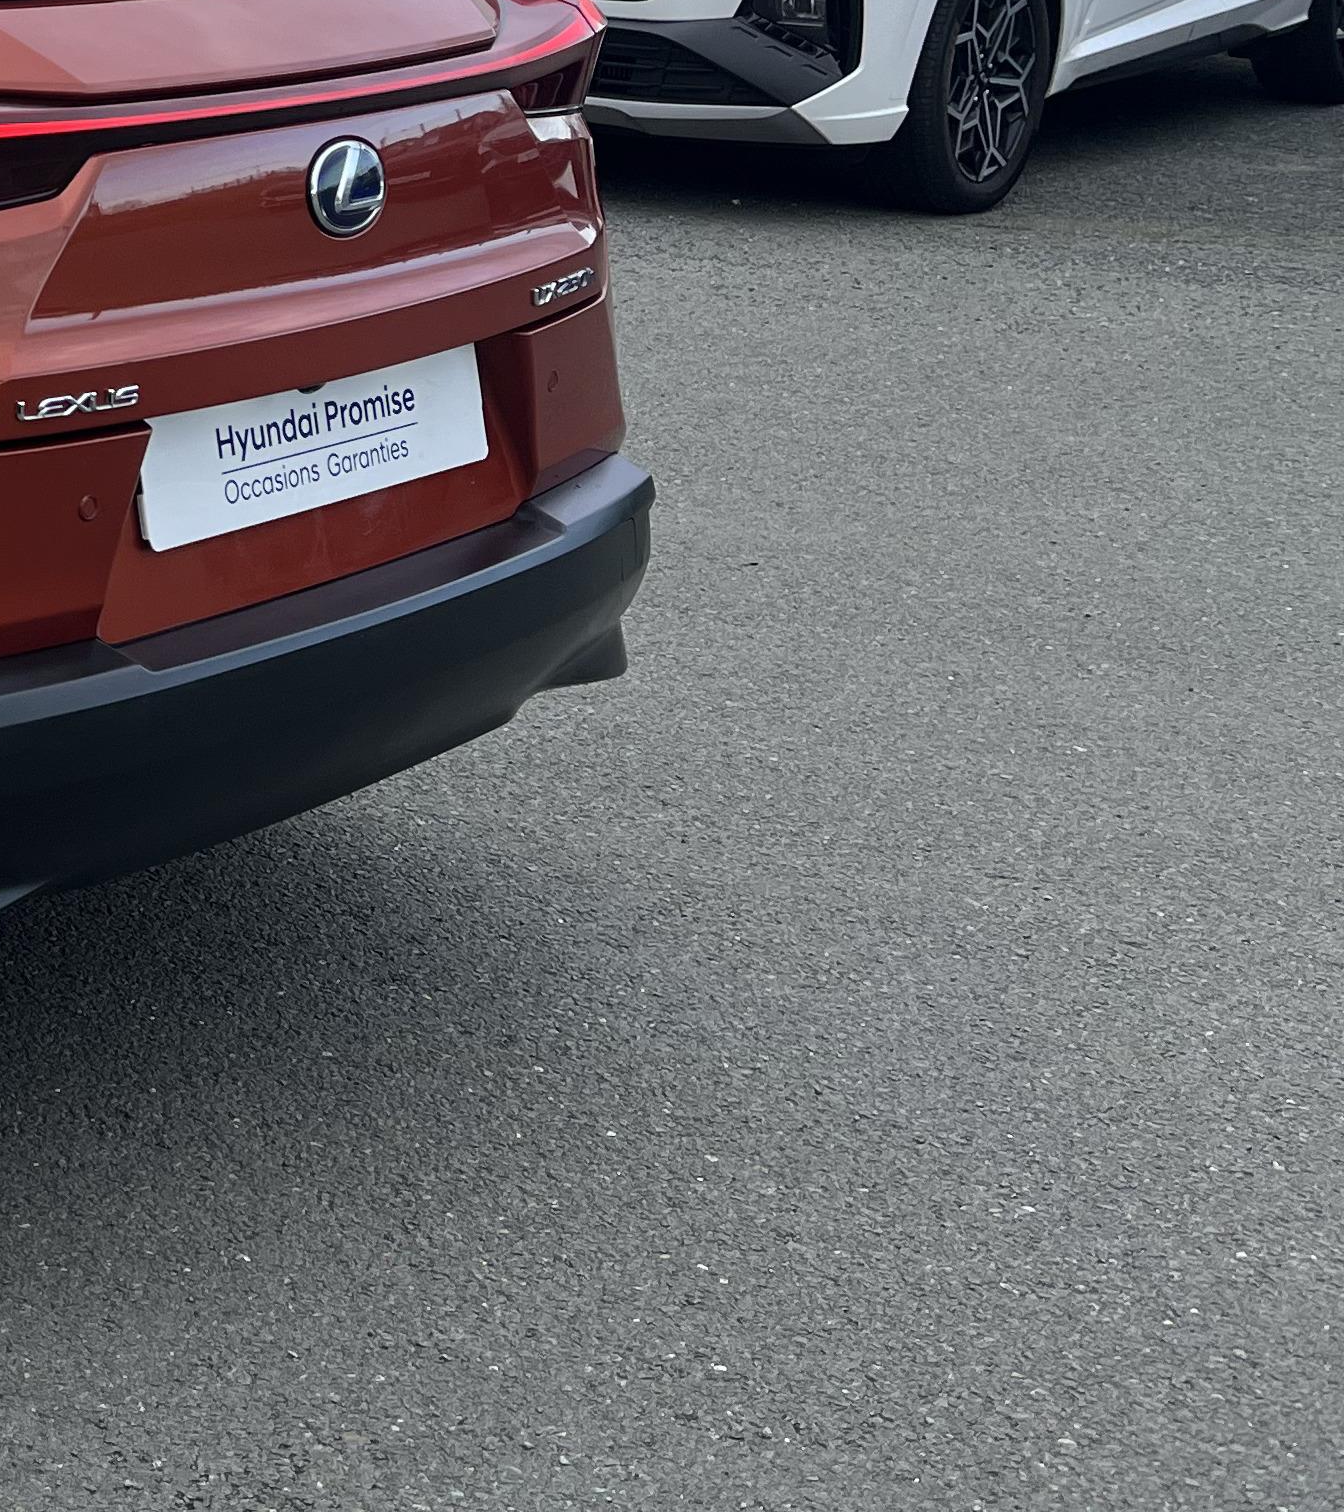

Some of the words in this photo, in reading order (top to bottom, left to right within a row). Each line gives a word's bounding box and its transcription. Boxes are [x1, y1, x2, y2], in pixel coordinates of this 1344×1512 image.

[16, 384, 140, 421] LEXUS
[215, 402, 320, 461] Hyundai
[324, 385, 415, 432] Promise
[224, 462, 321, 505] Occasions
[327, 437, 409, 477] Garanties
